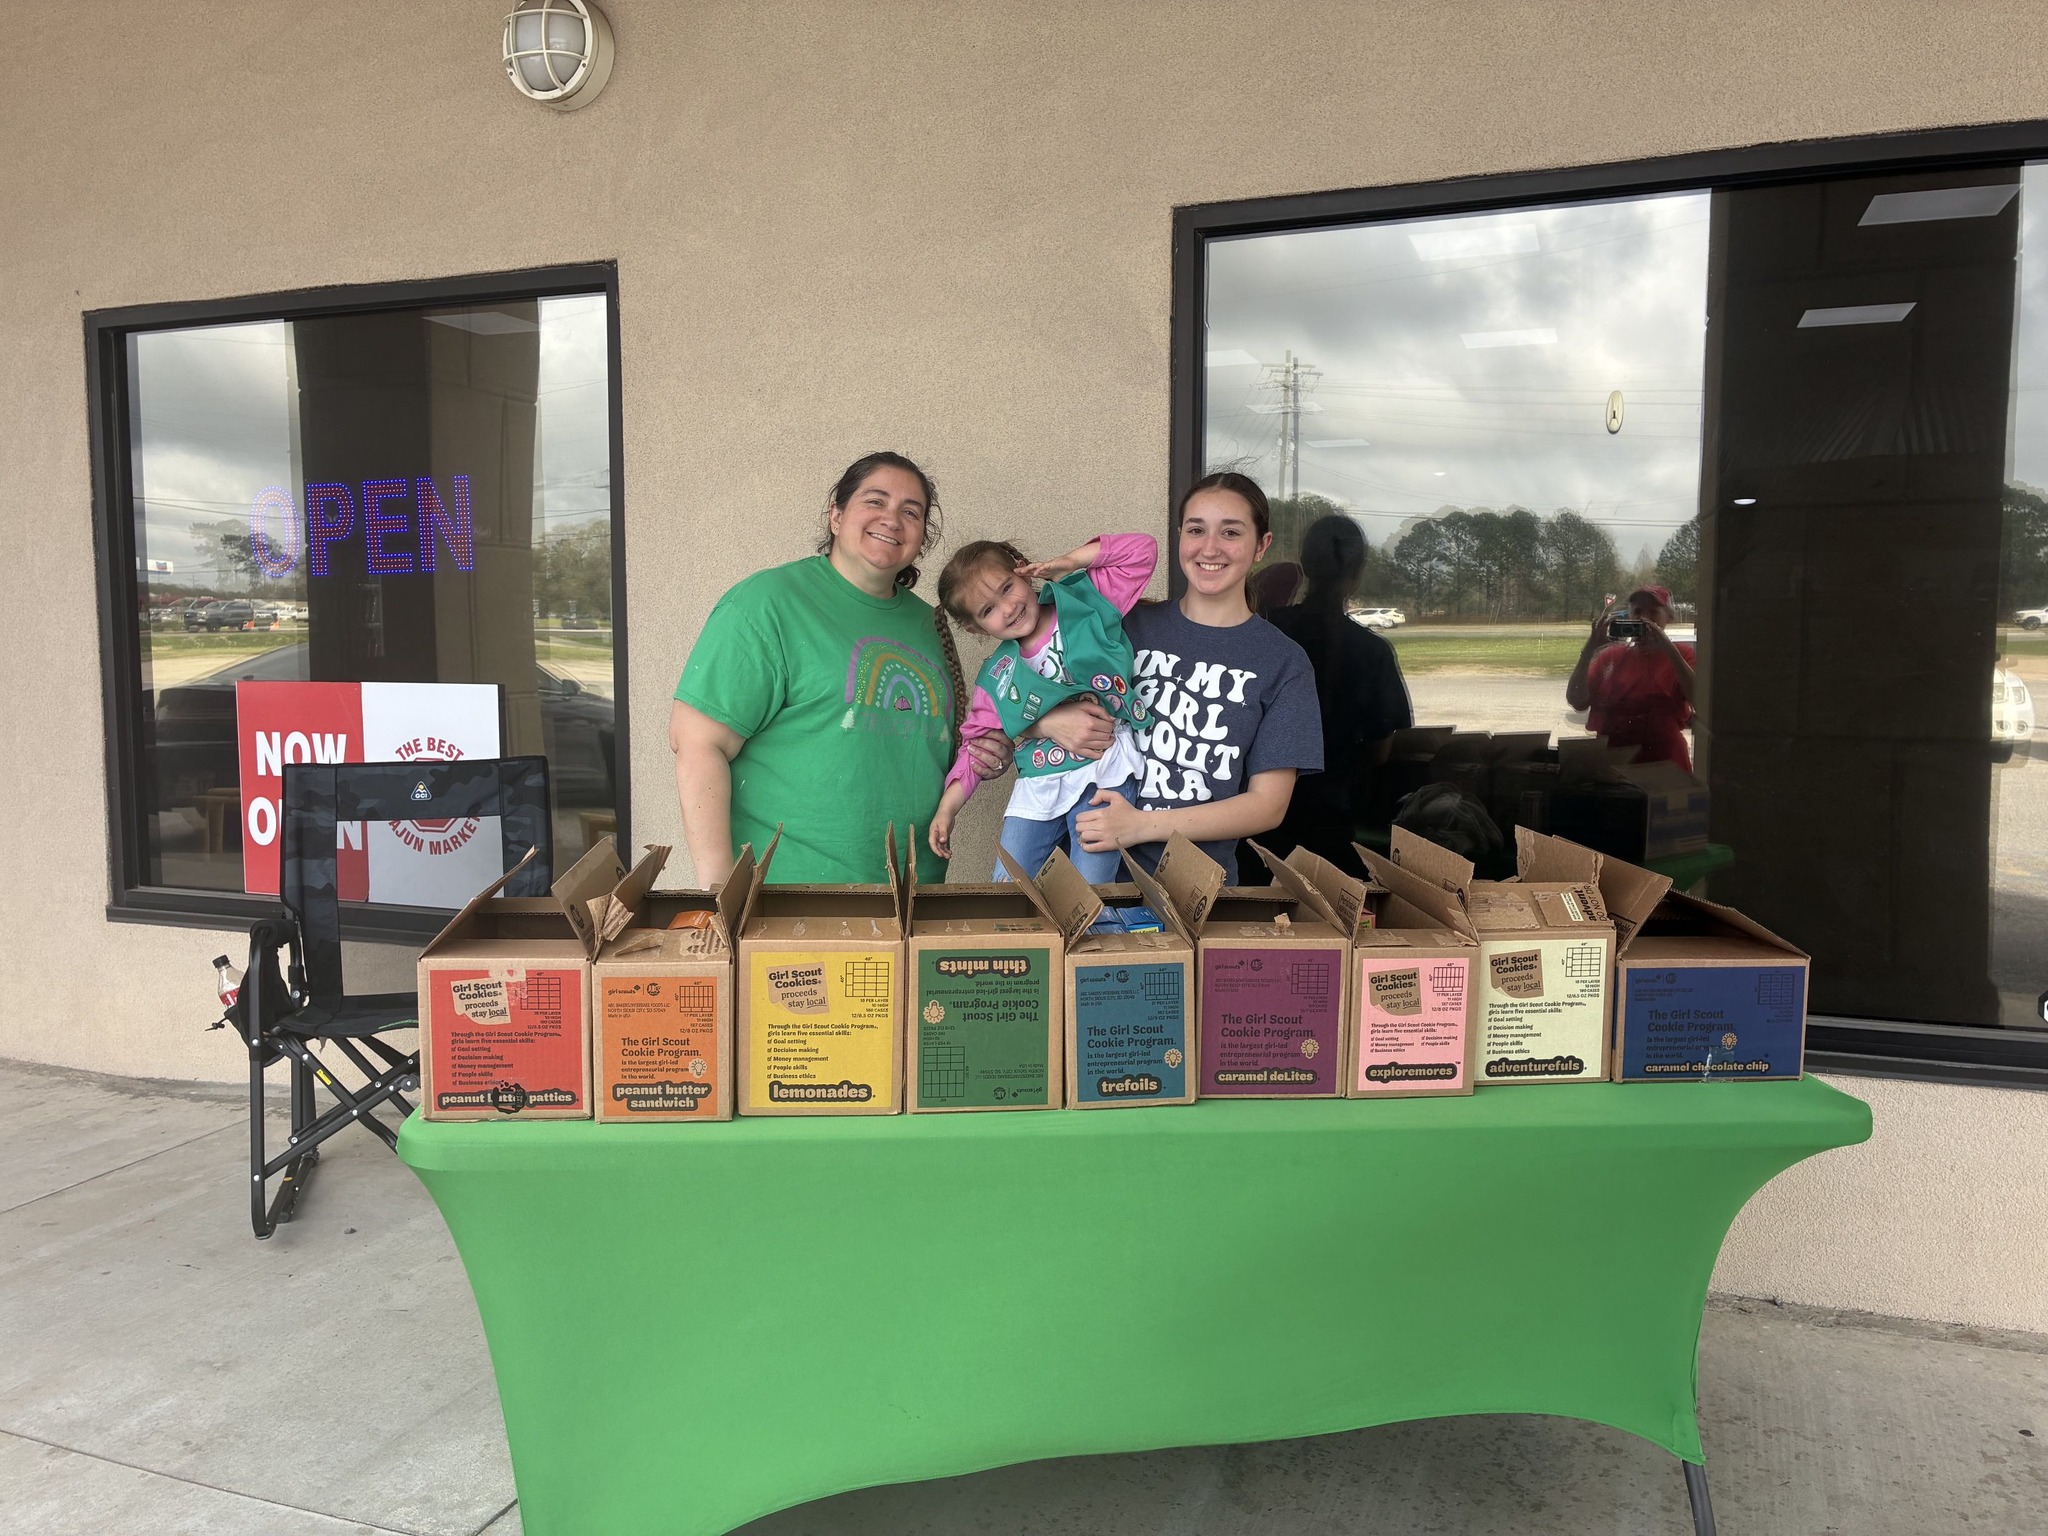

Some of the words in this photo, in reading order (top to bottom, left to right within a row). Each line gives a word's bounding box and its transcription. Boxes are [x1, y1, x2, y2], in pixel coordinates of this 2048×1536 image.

[251, 475, 473, 577] OPEN
[1134, 650, 1181, 677] IN
[1185, 662, 1257, 702] MY
[1134, 679, 1228, 741] GIRL
[256, 731, 347, 776] NOW
[395, 738, 423, 760] THE
[427, 737, 464, 760] BEST
[1134, 718, 1239, 780] COUT
[1140, 759, 1212, 801] RA
[248, 797, 362, 851] ON
[389, 820, 424, 852] AJUN
[1574, 887, 1597, 921] advent
[1589, 895, 1601, 910] NOT
[1597, 912, 1607, 921] DO
[1491, 957, 1508, 966] Girl
[1511, 954, 1538, 963] Scout
[940, 960, 989, 974] mints
[993, 960, 1027, 974] thin
[769, 971, 788, 981] Girl
[792, 968, 822, 977] Scout
[1370, 975, 1388, 984] Girl
[1390, 972, 1417, 982] Scout
[1501, 973, 1533, 984] proceeds
[453, 984, 471, 993] Girl
[474, 981, 502, 990] Scout
[1507, 984, 1522, 992] stay
[1524, 981, 1540, 991] local
[781, 989, 817, 1000] proceeds
[1381, 991, 1412, 1002] proceeds
[465, 1001, 498, 1010] proceeds
[788, 1000, 804, 1008] stay
[807, 997, 826, 1006] local
[1003, 1000, 1038, 1009] Cookie
[1387, 1001, 1401, 1009] stay
[1403, 999, 1419, 1008] local
[472, 1010, 488, 1018] stay
[489, 1008, 507, 1017] local
[963, 1012, 993, 1021] Scout
[997, 1012, 1016, 1022] Girl
[1019, 1012, 1038, 1021] The
[1649, 1010, 1667, 1019] The
[1671, 1009, 1690, 1019] Girl
[1694, 1009, 1724, 1019] Scout
[1222, 1014, 1242, 1024] The
[1246, 1014, 1266, 1024] Girl
[1270, 1014, 1302, 1024] Scout
[1087, 1026, 1106, 1036] The
[1110, 1025, 1129, 1034] Girl
[1133, 1025, 1163, 1034] Scout
[1221, 1027, 1260, 1037] Cookie
[1648, 1022, 1684, 1032] Cookie
[622, 1038, 639, 1046] The
[642, 1038, 659, 1046] Girl
[662, 1038, 690, 1046] Scout
[1087, 1038, 1124, 1048] Cookie
[622, 1048, 654, 1056] Cookie
[1106, 1051, 1127, 1059] largest
[1490, 1060, 1580, 1073] adventurefuls
[1645, 1062, 1690, 1072] caramel
[1746, 1061, 1769, 1072] chip
[1218, 1071, 1267, 1081] caramel
[1270, 1071, 1313, 1081] deLites
[1370, 1067, 1452, 1079] exploremores
[1102, 1078, 1158, 1092] trefoils
[617, 1086, 662, 1097] peanut
[666, 1085, 708, 1095] butter
[773, 1085, 868, 1098] lemonades
[442, 1094, 485, 1105] peanut
[529, 1092, 572, 1103] patties
[631, 1097, 694, 1107] sandwich
